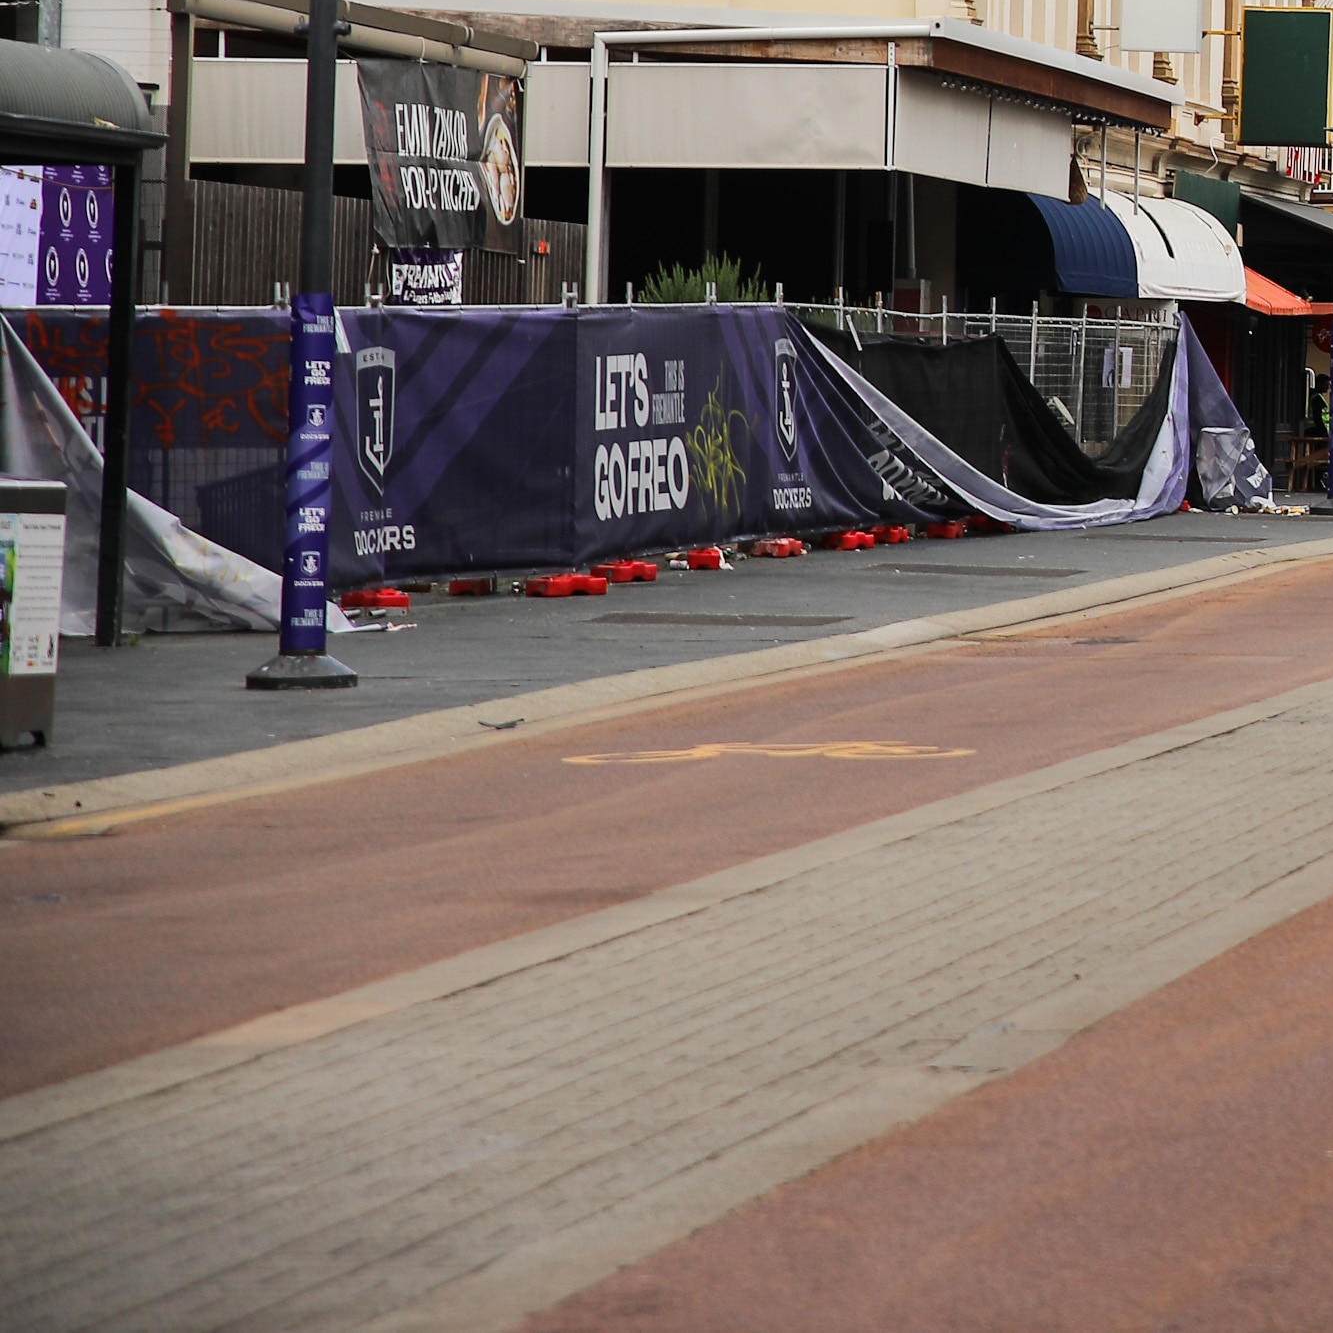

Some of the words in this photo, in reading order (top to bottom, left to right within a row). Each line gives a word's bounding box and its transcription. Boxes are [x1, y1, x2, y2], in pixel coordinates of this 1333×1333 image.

[1104, 305, 1167, 323] CAPRI
[594, 352, 650, 432] LET'S
[652, 392, 686, 426] FREMANTLE
[594, 442, 626, 522] GO
[627, 435, 690, 516] FREO
[299, 507, 326, 517] LET'S
[772, 486, 812, 510] DOCKERS
